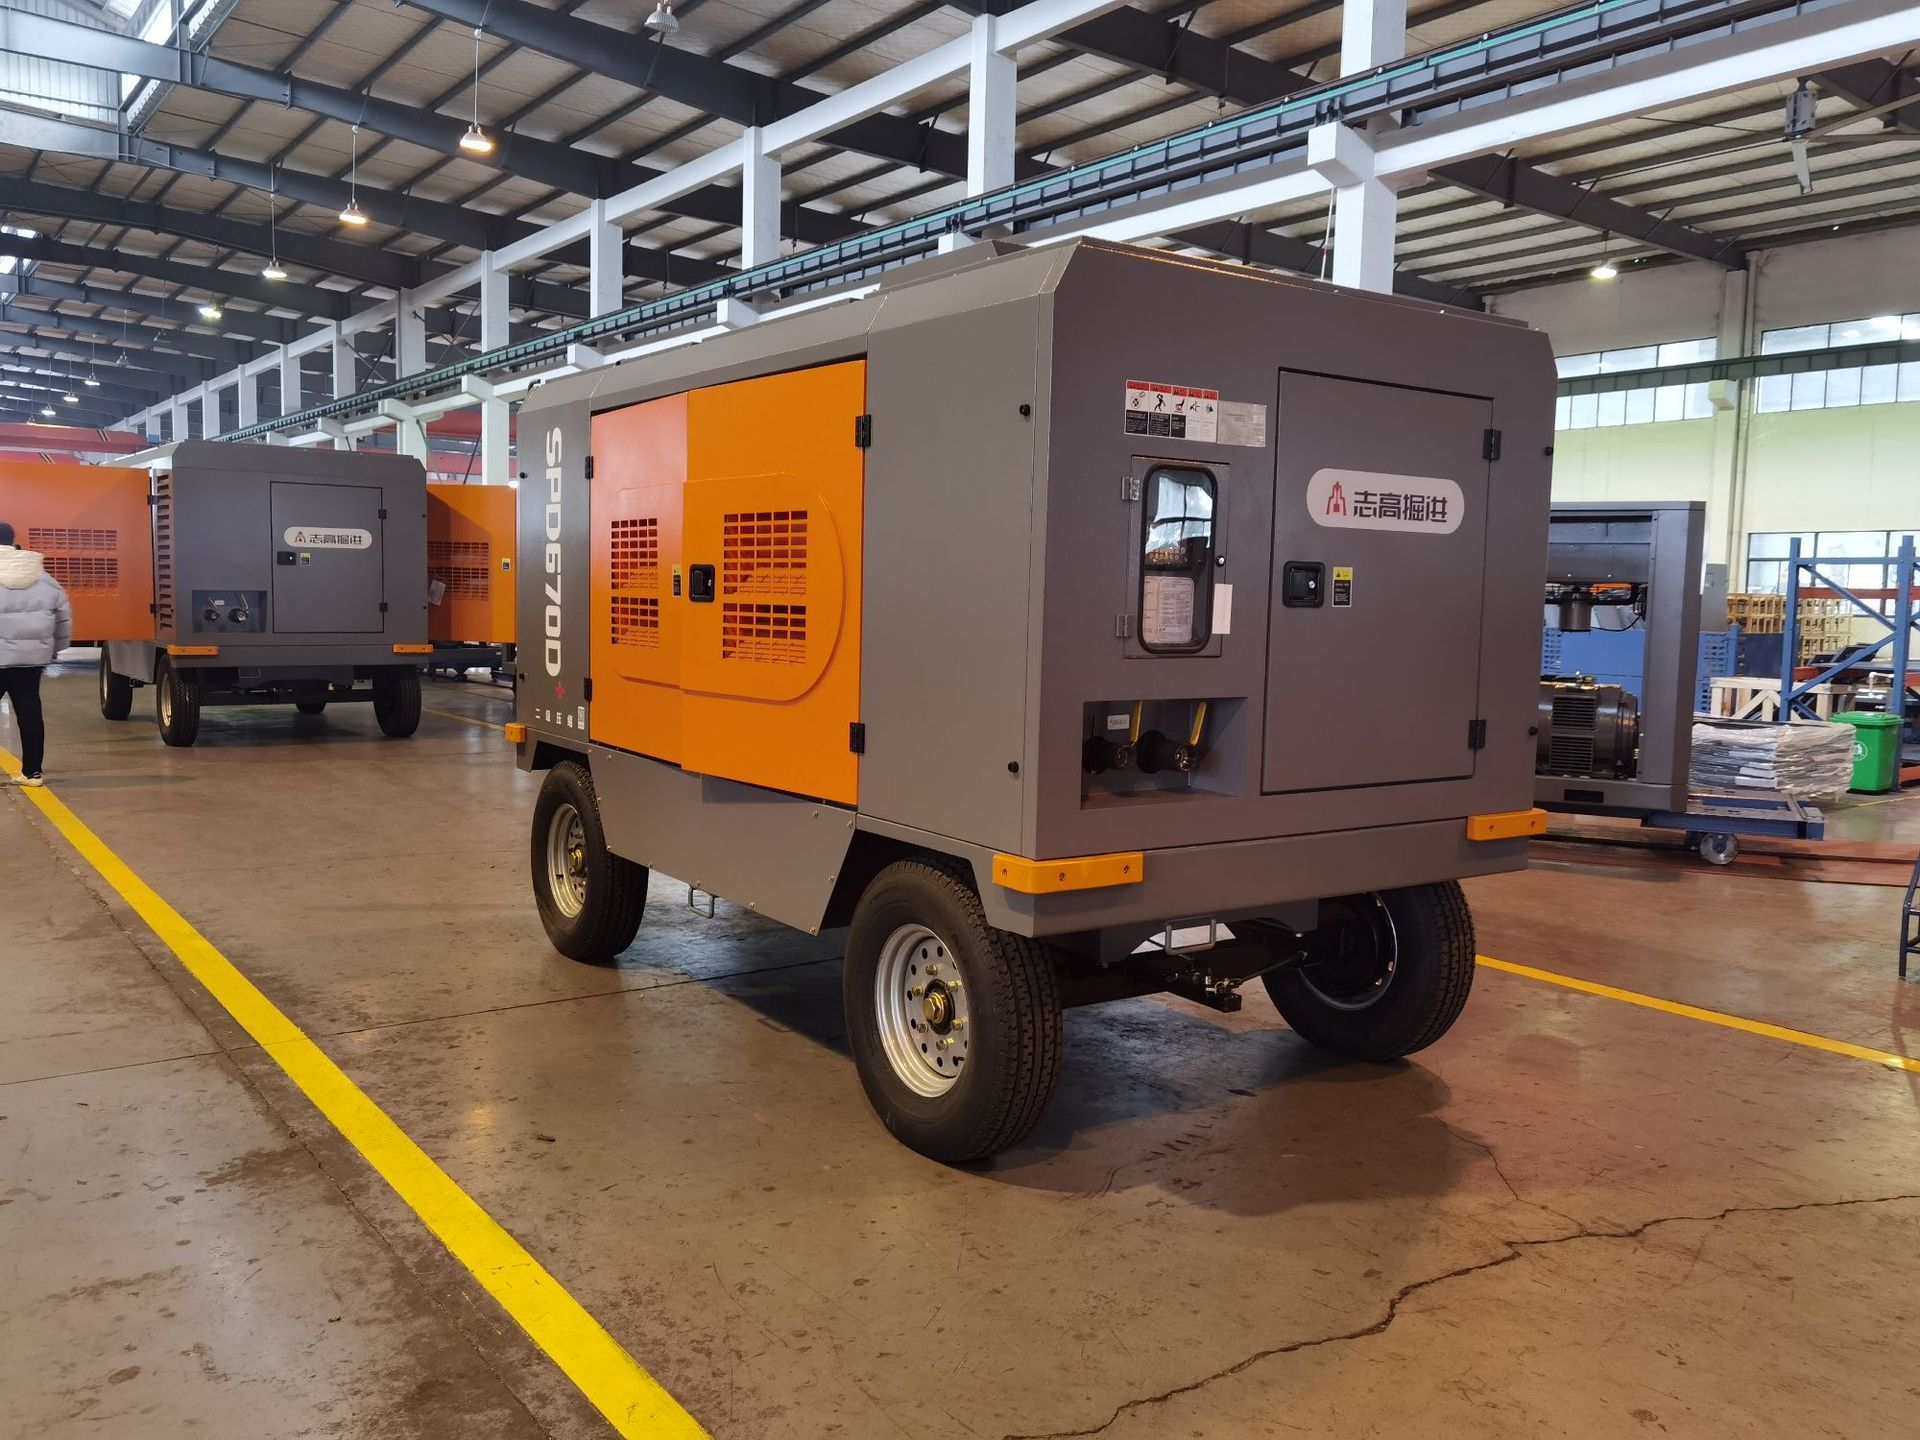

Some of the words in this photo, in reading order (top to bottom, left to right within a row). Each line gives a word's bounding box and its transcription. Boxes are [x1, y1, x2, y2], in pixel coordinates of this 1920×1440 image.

[545, 426, 562, 677] SPD670D
[1353, 490, 1448, 523] 志高掘进
